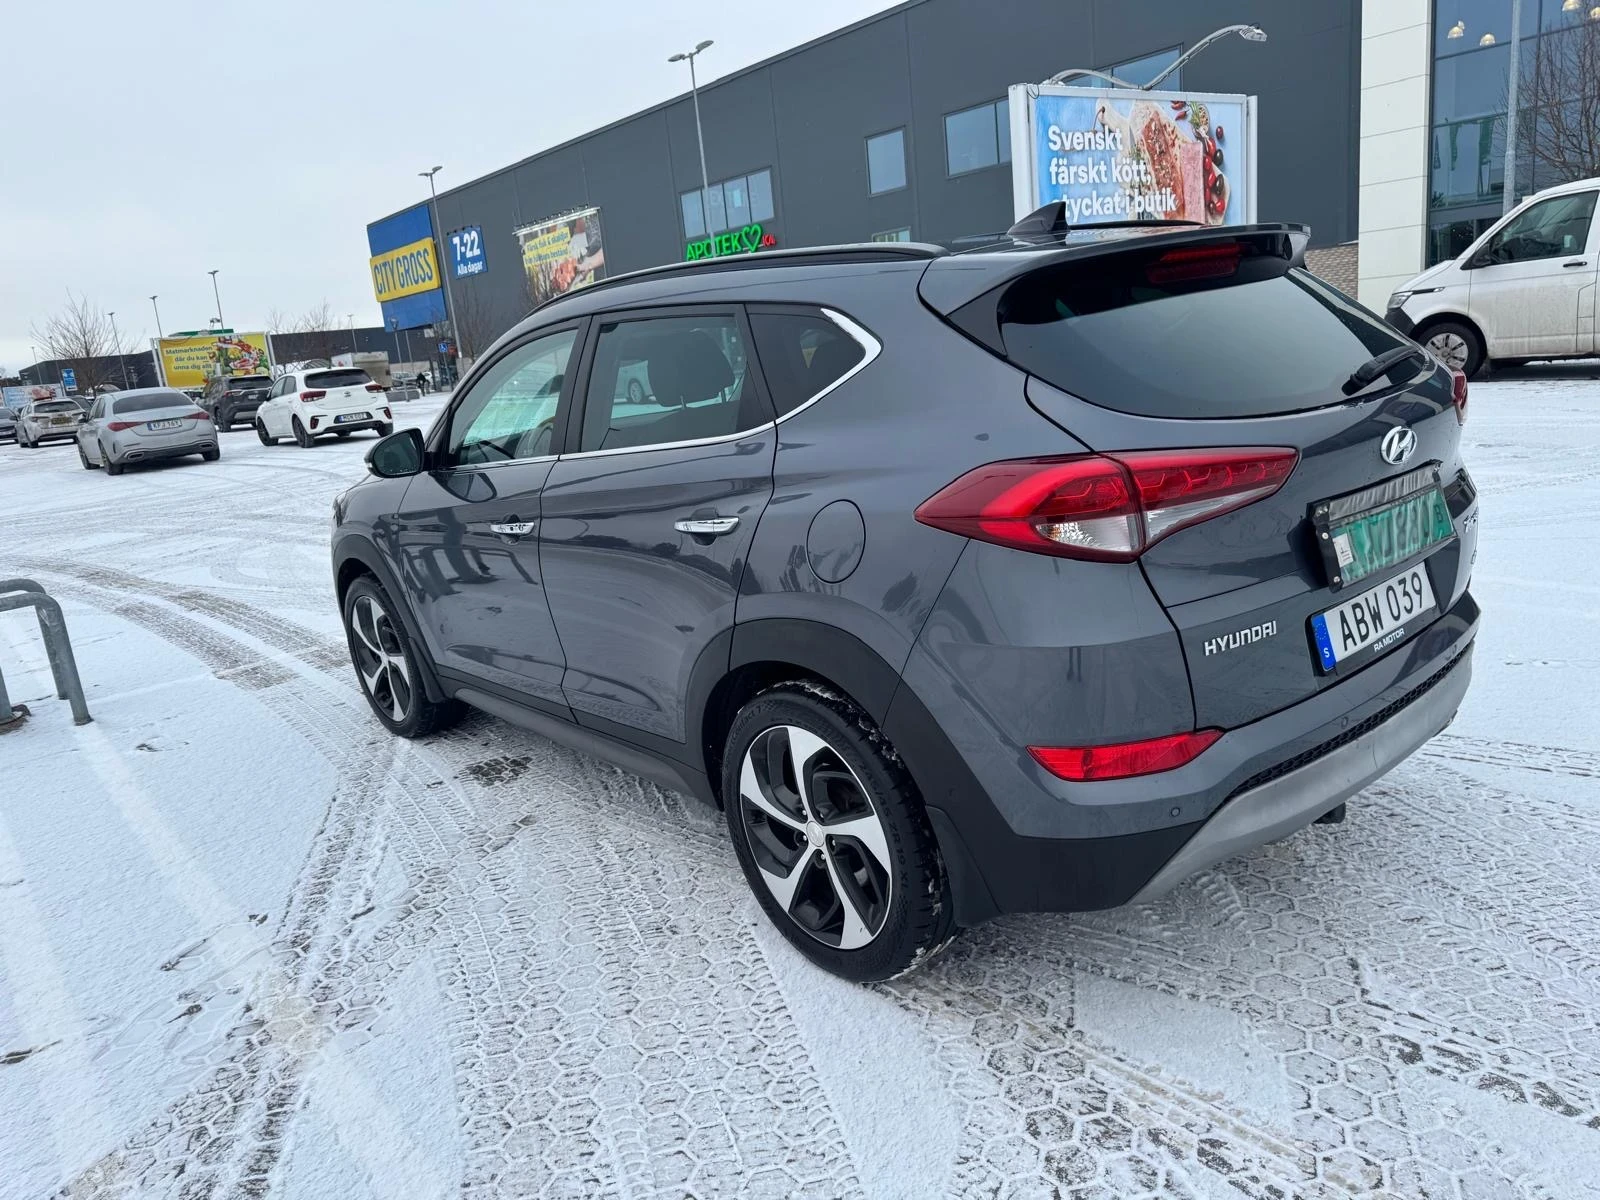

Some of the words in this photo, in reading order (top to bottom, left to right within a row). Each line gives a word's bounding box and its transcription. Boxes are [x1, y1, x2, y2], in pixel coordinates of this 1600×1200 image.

[1048, 125, 1123, 151] Svenskt
[1049, 157, 1108, 185] färskt
[1111, 158, 1152, 186] kött,
[1125, 191, 1130, 213] i
[1134, 187, 1177, 213] butik
[452, 230, 481, 261] 7-22
[686, 231, 742, 261] APOTEK
[374, 260, 397, 295] CITY
[396, 247, 433, 289] GROSS
[457, 262, 468, 276] Alla
[468, 260, 483, 274] dagar
[165, 345, 213, 355] Matmarknaden
[1339, 592, 1384, 652] ABW
[1385, 571, 1424, 622] 039
[1204, 620, 1277, 657] HYUNDAI
[1373, 642, 1384, 652] RA
[1383, 627, 1405, 647] MOTOR
[1323, 647, 1330, 658] S
